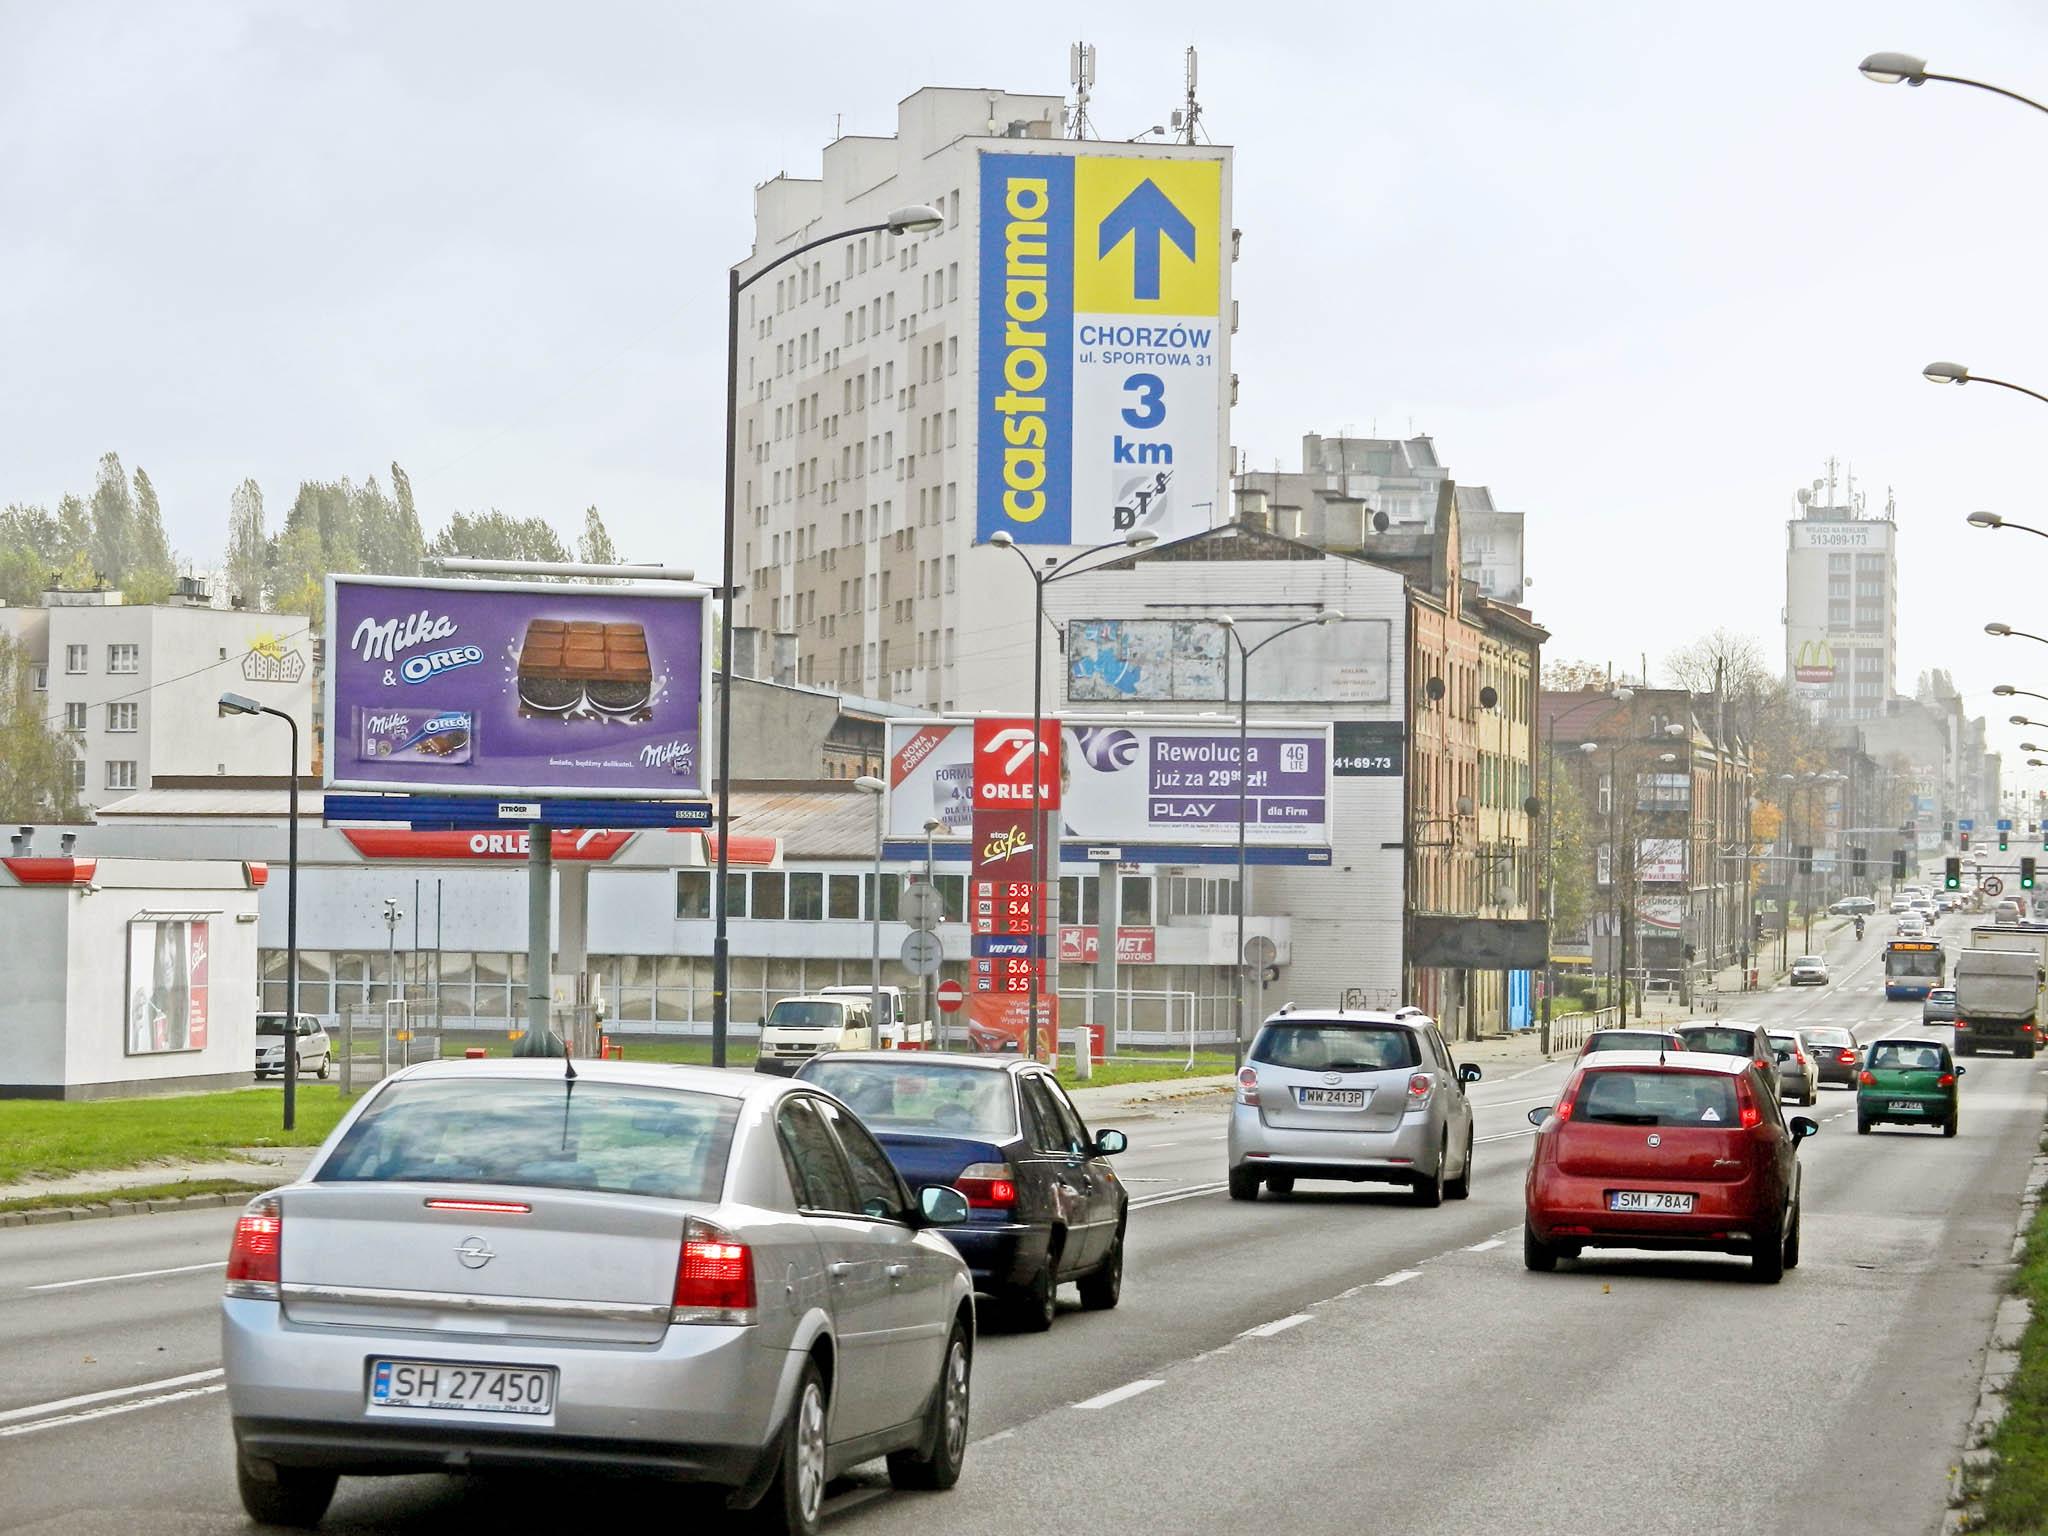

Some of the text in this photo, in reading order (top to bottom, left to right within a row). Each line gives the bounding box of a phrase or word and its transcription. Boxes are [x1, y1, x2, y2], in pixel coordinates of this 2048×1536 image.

[1079, 322, 1211, 349] CHORZÓW
[994, 177, 1049, 523] castorama
[1079, 351, 1211, 367] ul. SPORTOWA 31
[1120, 373, 1167, 430] 3
[1113, 435, 1173, 465] km
[1114, 471, 1167, 530] DTS
[351, 610, 458, 662] Milka
[382, 645, 482, 686] & OREO
[367, 713, 410, 734] Milka
[640, 740, 693, 768] Milka
[902, 735, 928, 762] NOWA
[902, 735, 939, 773] FORMUŁA
[1157, 742, 1259, 766] Rewoluca
[1286, 745, 1304, 761] 4G
[1290, 761, 1303, 770] LTE
[1332, 757, 1392, 769] 41-69-73
[1154, 769, 1181, 789] już
[1185, 773, 1204, 786] za
[1246, 770, 1268, 787] zł!
[982, 783, 1049, 799] ORLEN
[500, 805, 528, 813] STRÖER
[1154, 803, 1216, 817] PLAY
[1267, 806, 1309, 817] dla Firm
[469, 834, 530, 854] ORLE
[983, 824, 1027, 863] cafe
[990, 831, 1009, 840] stop
[989, 944, 1029, 954] verva
[1306, 1090, 1362, 1103] WW 2413P
[1620, 1193, 1691, 1209] SMI 78A4
[395, 1367, 544, 1404] SH 27450
